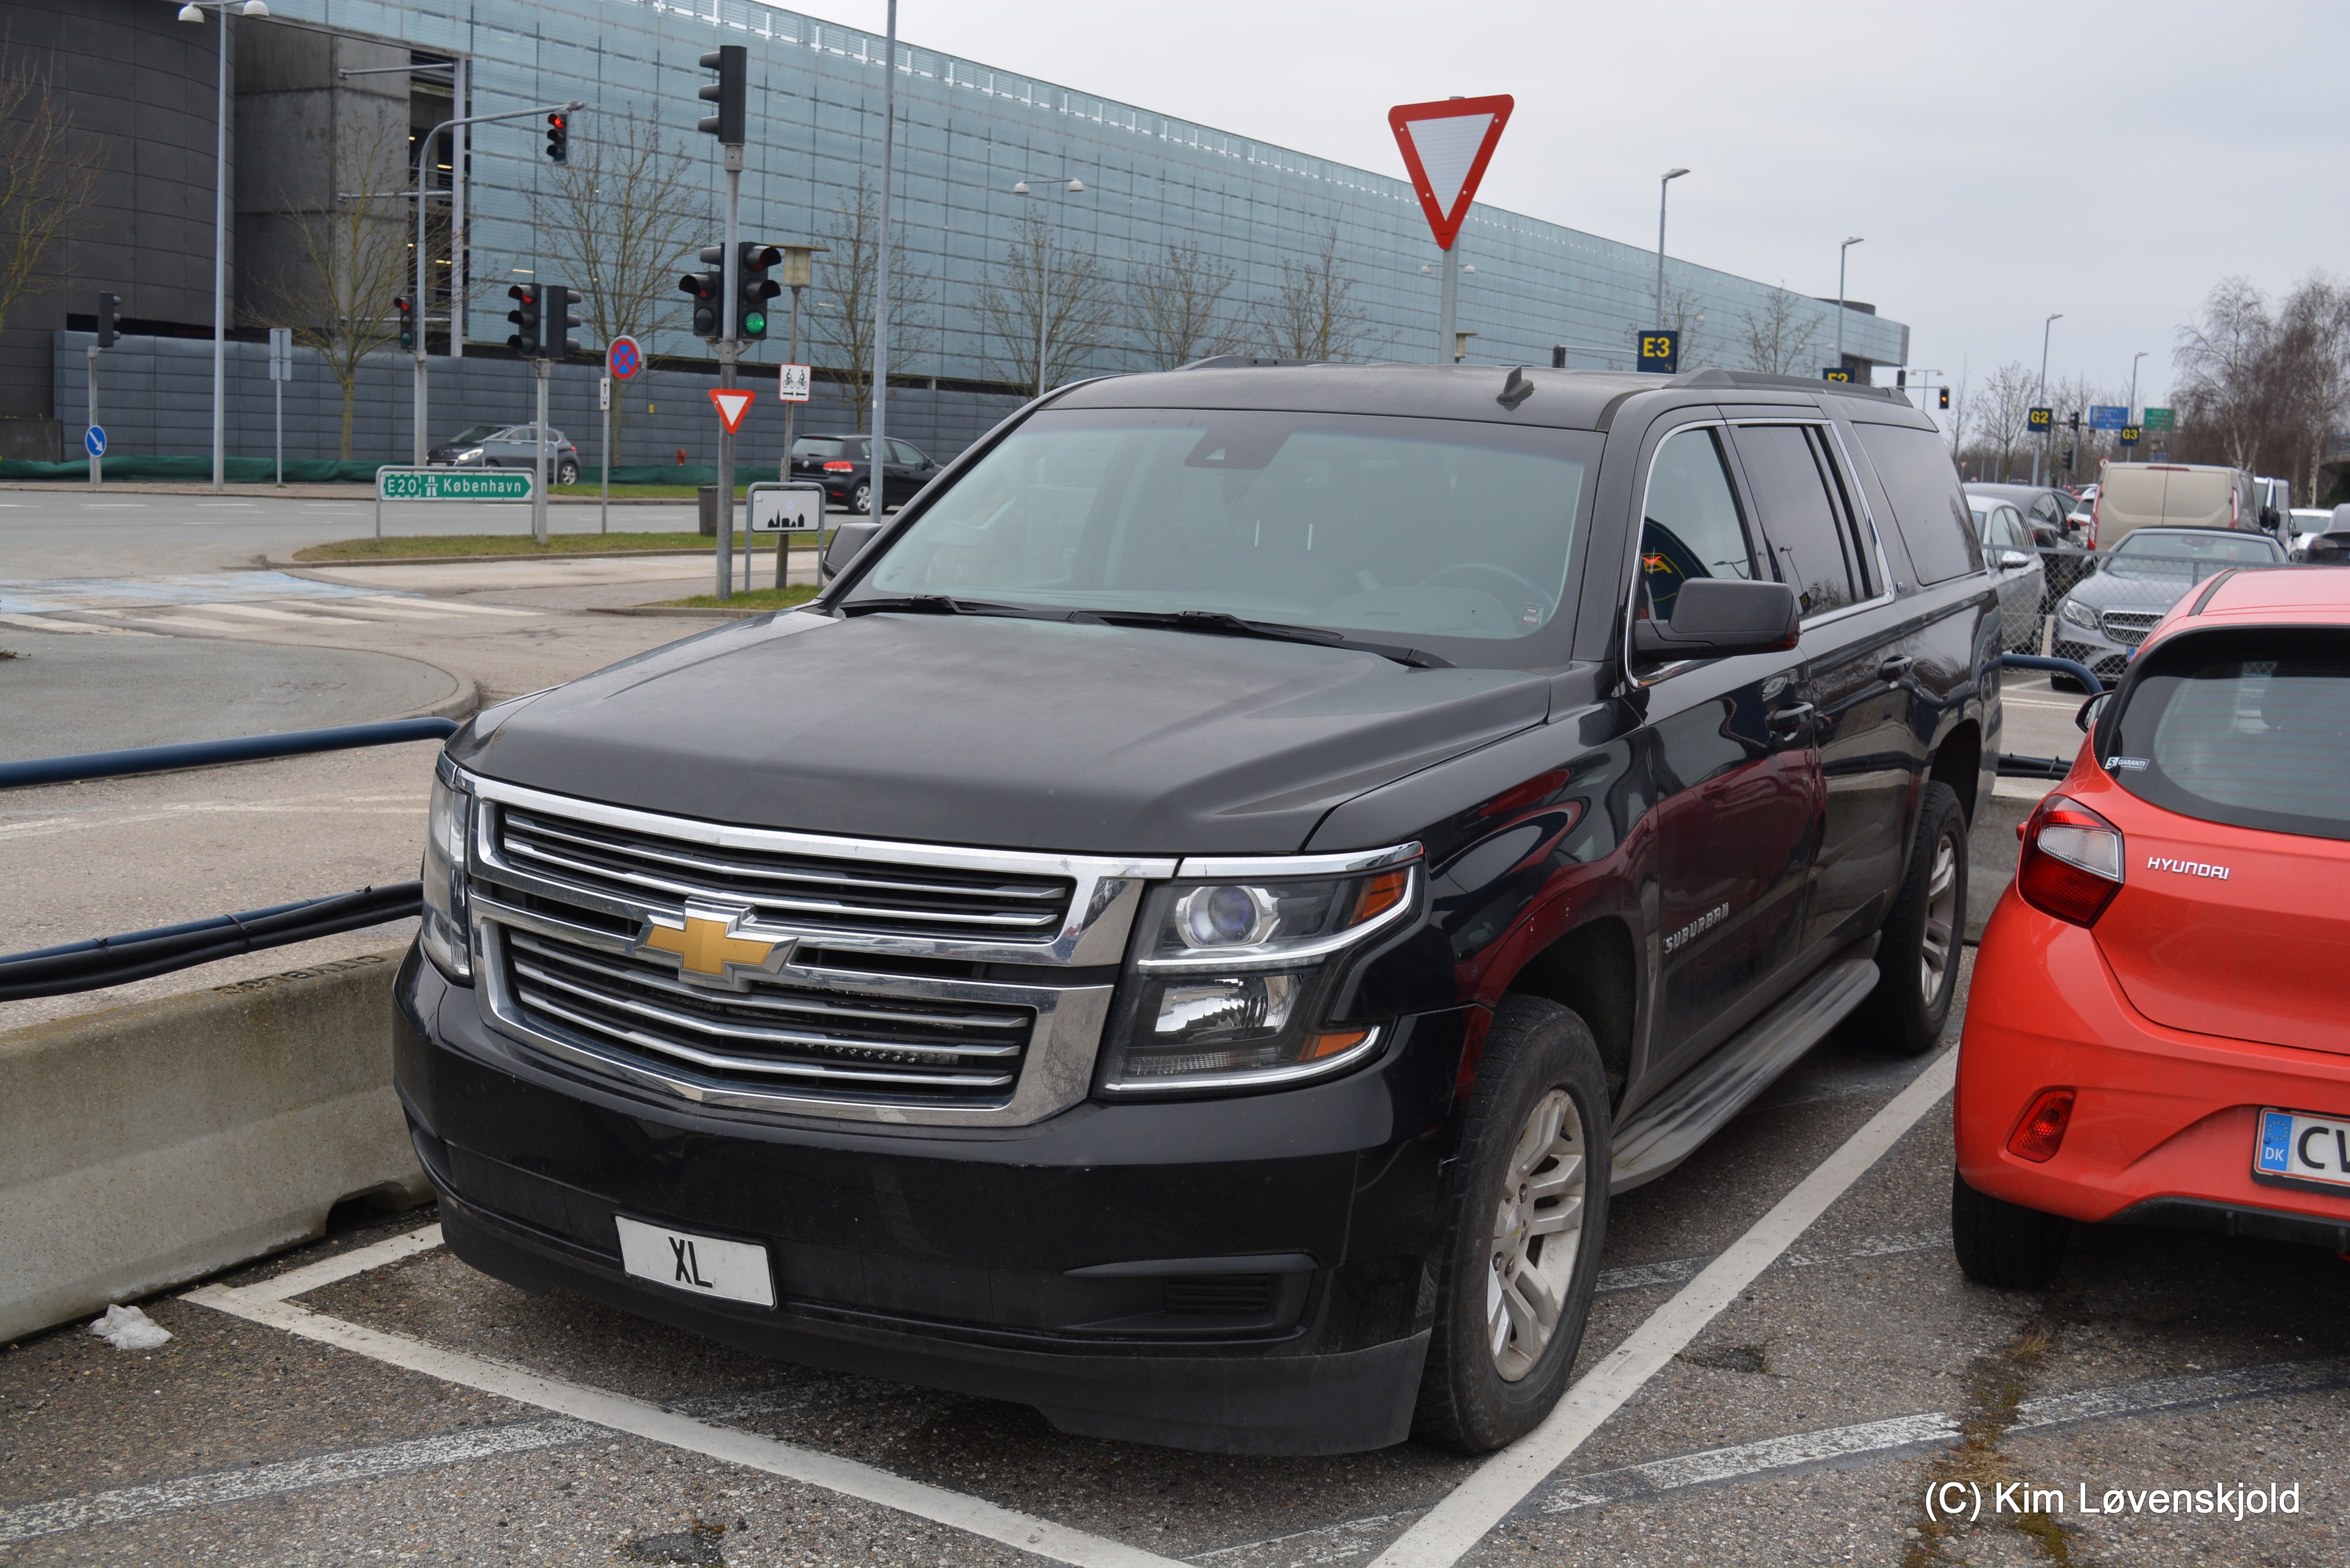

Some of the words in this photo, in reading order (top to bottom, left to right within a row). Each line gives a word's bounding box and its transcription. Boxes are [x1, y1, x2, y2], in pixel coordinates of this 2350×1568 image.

[1643, 337, 1670, 357] E3
[2031, 411, 2049, 424] G2
[2122, 428, 2138, 440] G3
[387, 479, 417, 493] E20
[444, 479, 521, 493] København
[2147, 856, 2230, 880] HYUNDAI
[1664, 902, 1729, 954] SUBURBAN
[2264, 1147, 2285, 1162] DK
[668, 1236, 713, 1288] XL
